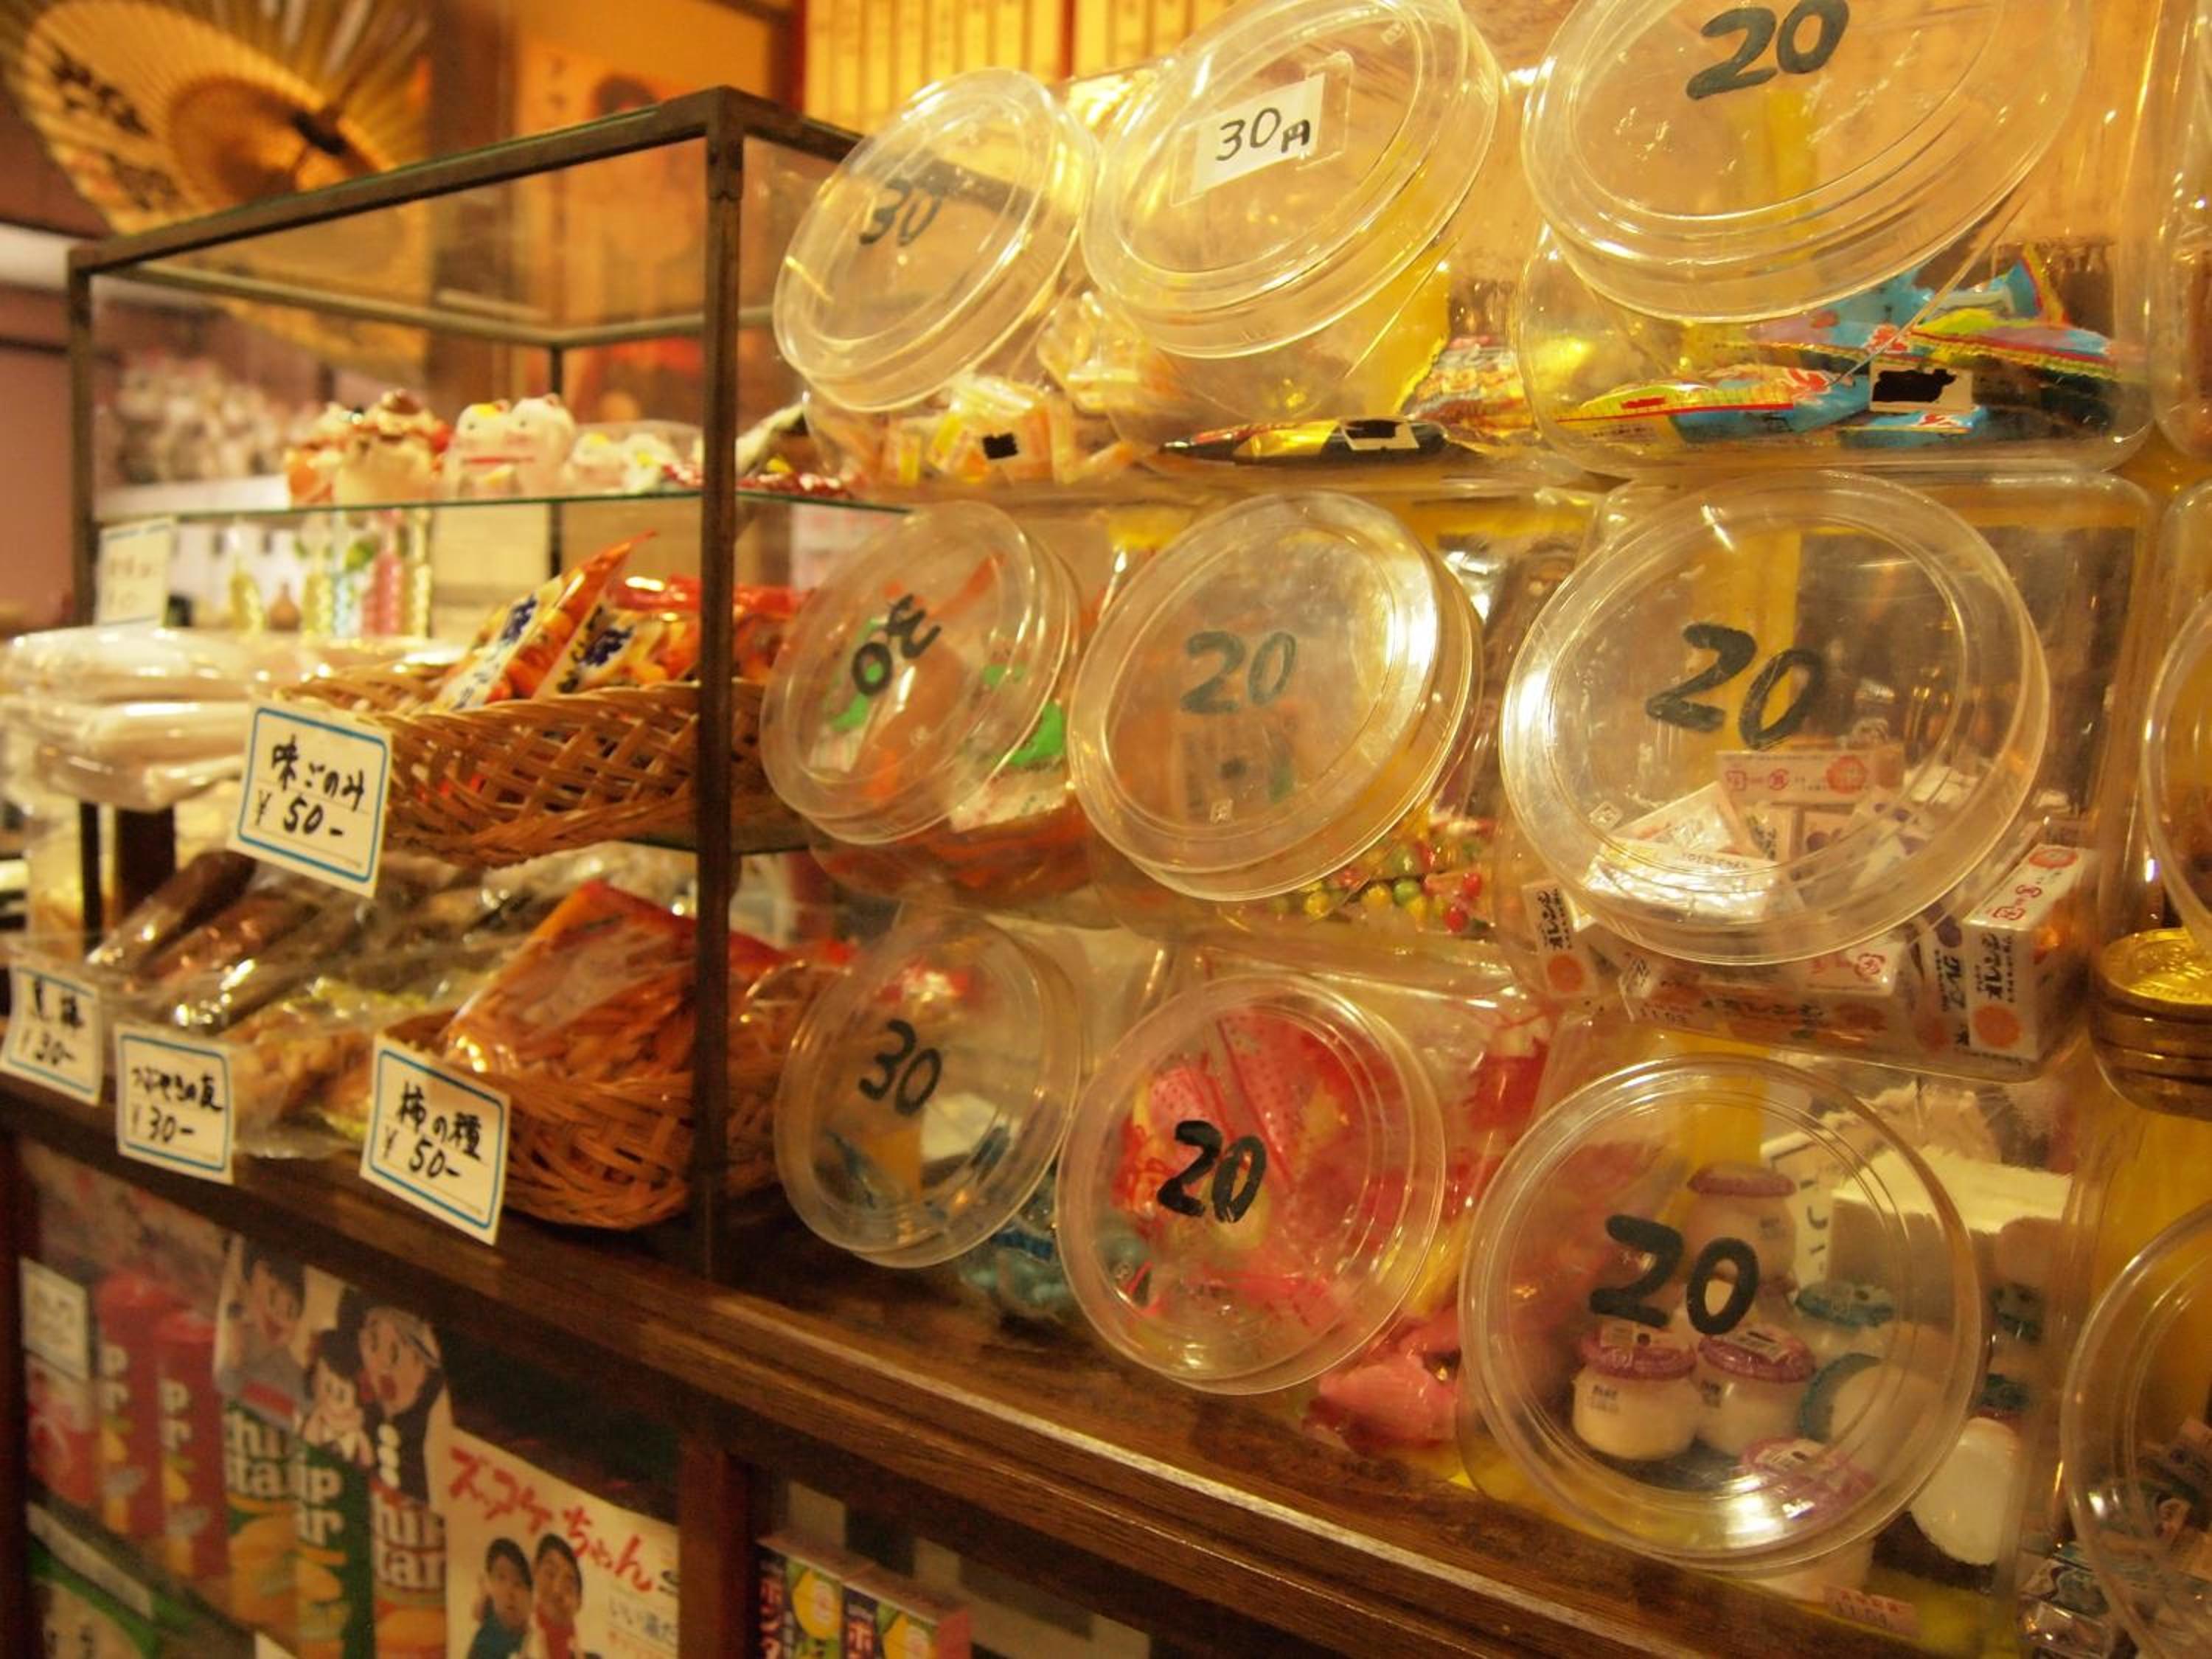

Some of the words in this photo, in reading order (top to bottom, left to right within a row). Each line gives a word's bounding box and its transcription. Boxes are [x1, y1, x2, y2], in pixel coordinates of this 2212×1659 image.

[1686, 0, 1849, 100] 20
[1215, 107, 1311, 161] 30円
[859, 178, 944, 247] 30
[1182, 630, 1298, 715] 20
[1646, 623, 1825, 751] 20
[271, 734, 364, 813] 味ごのみ
[858, 1018, 943, 1116] 30
[1157, 1119, 1267, 1224] 20
[1590, 1214, 1759, 1335] 20
